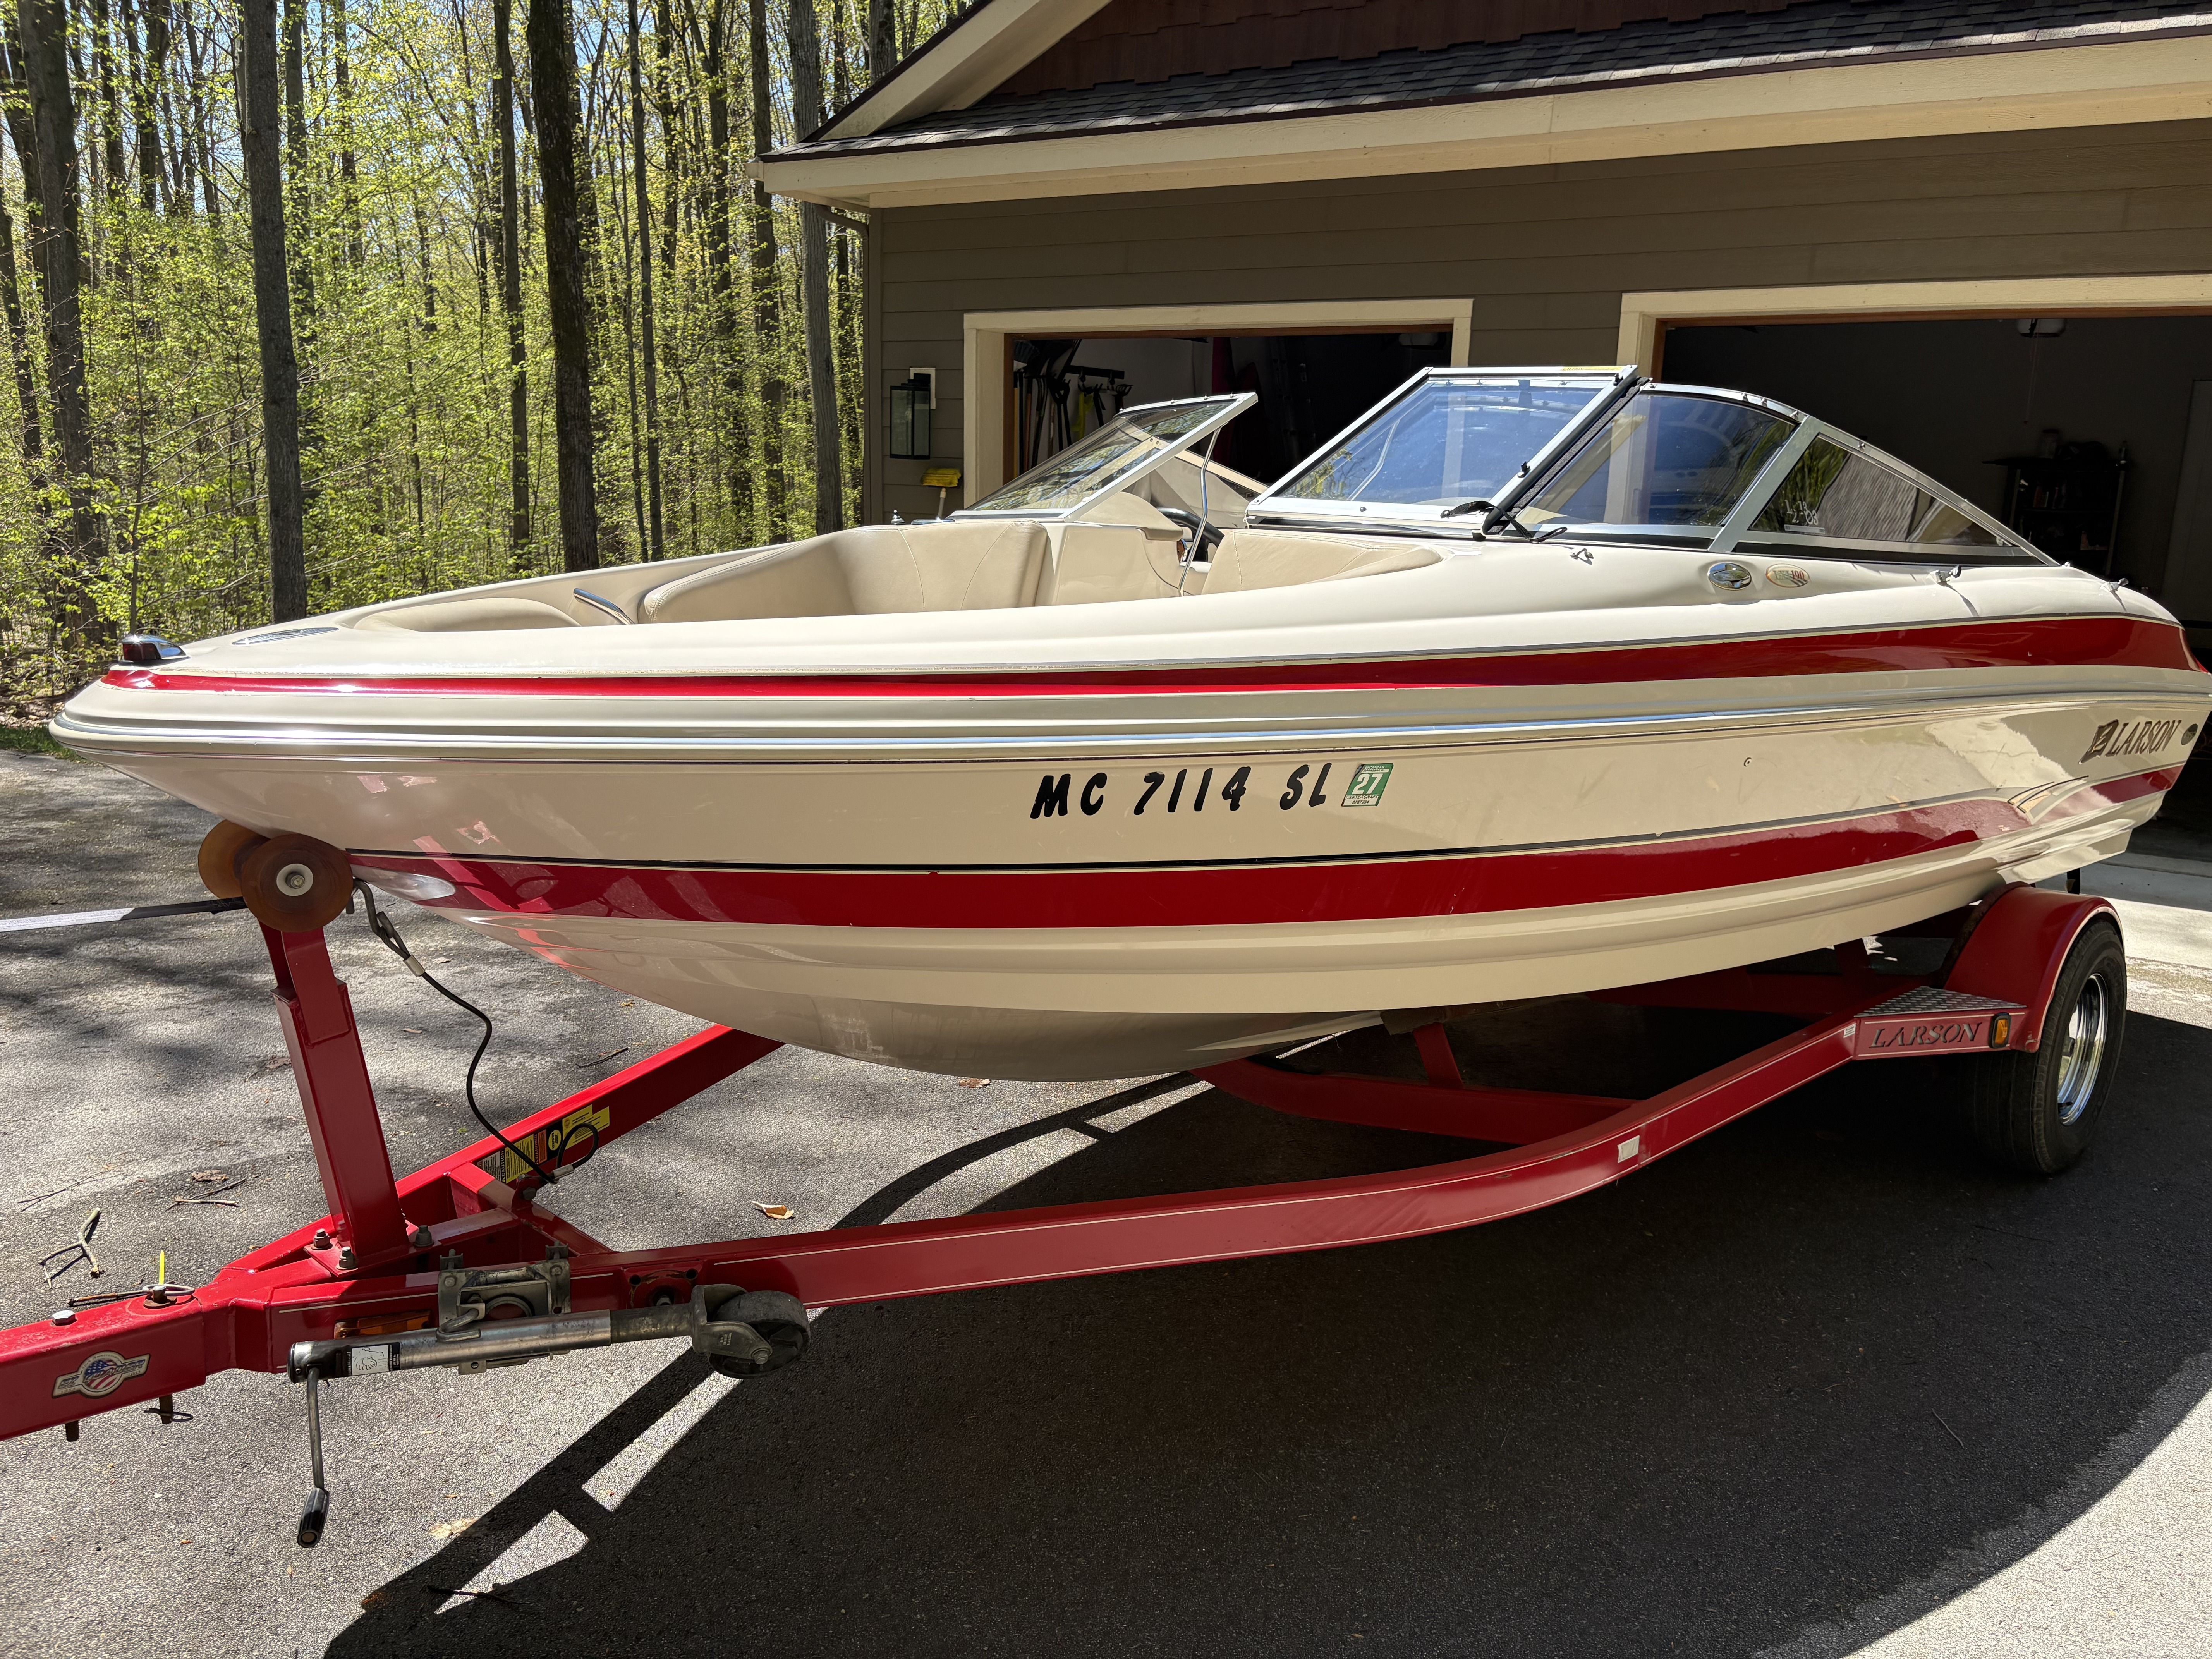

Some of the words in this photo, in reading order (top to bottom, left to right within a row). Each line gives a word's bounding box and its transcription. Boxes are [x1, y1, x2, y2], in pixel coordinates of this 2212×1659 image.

[1791, 570, 1805, 580] 190
[2105, 720, 2182, 757] LARSON
[1030, 773, 1107, 819] MC
[1134, 766, 1251, 815] 7114
[1280, 763, 1332, 810] SL
[1352, 773, 1383, 794] 27
[1869, 1022, 1982, 1048] LARSON
[58, 1376, 80, 1389] EZ
[83, 1359, 146, 1383] LOADER
